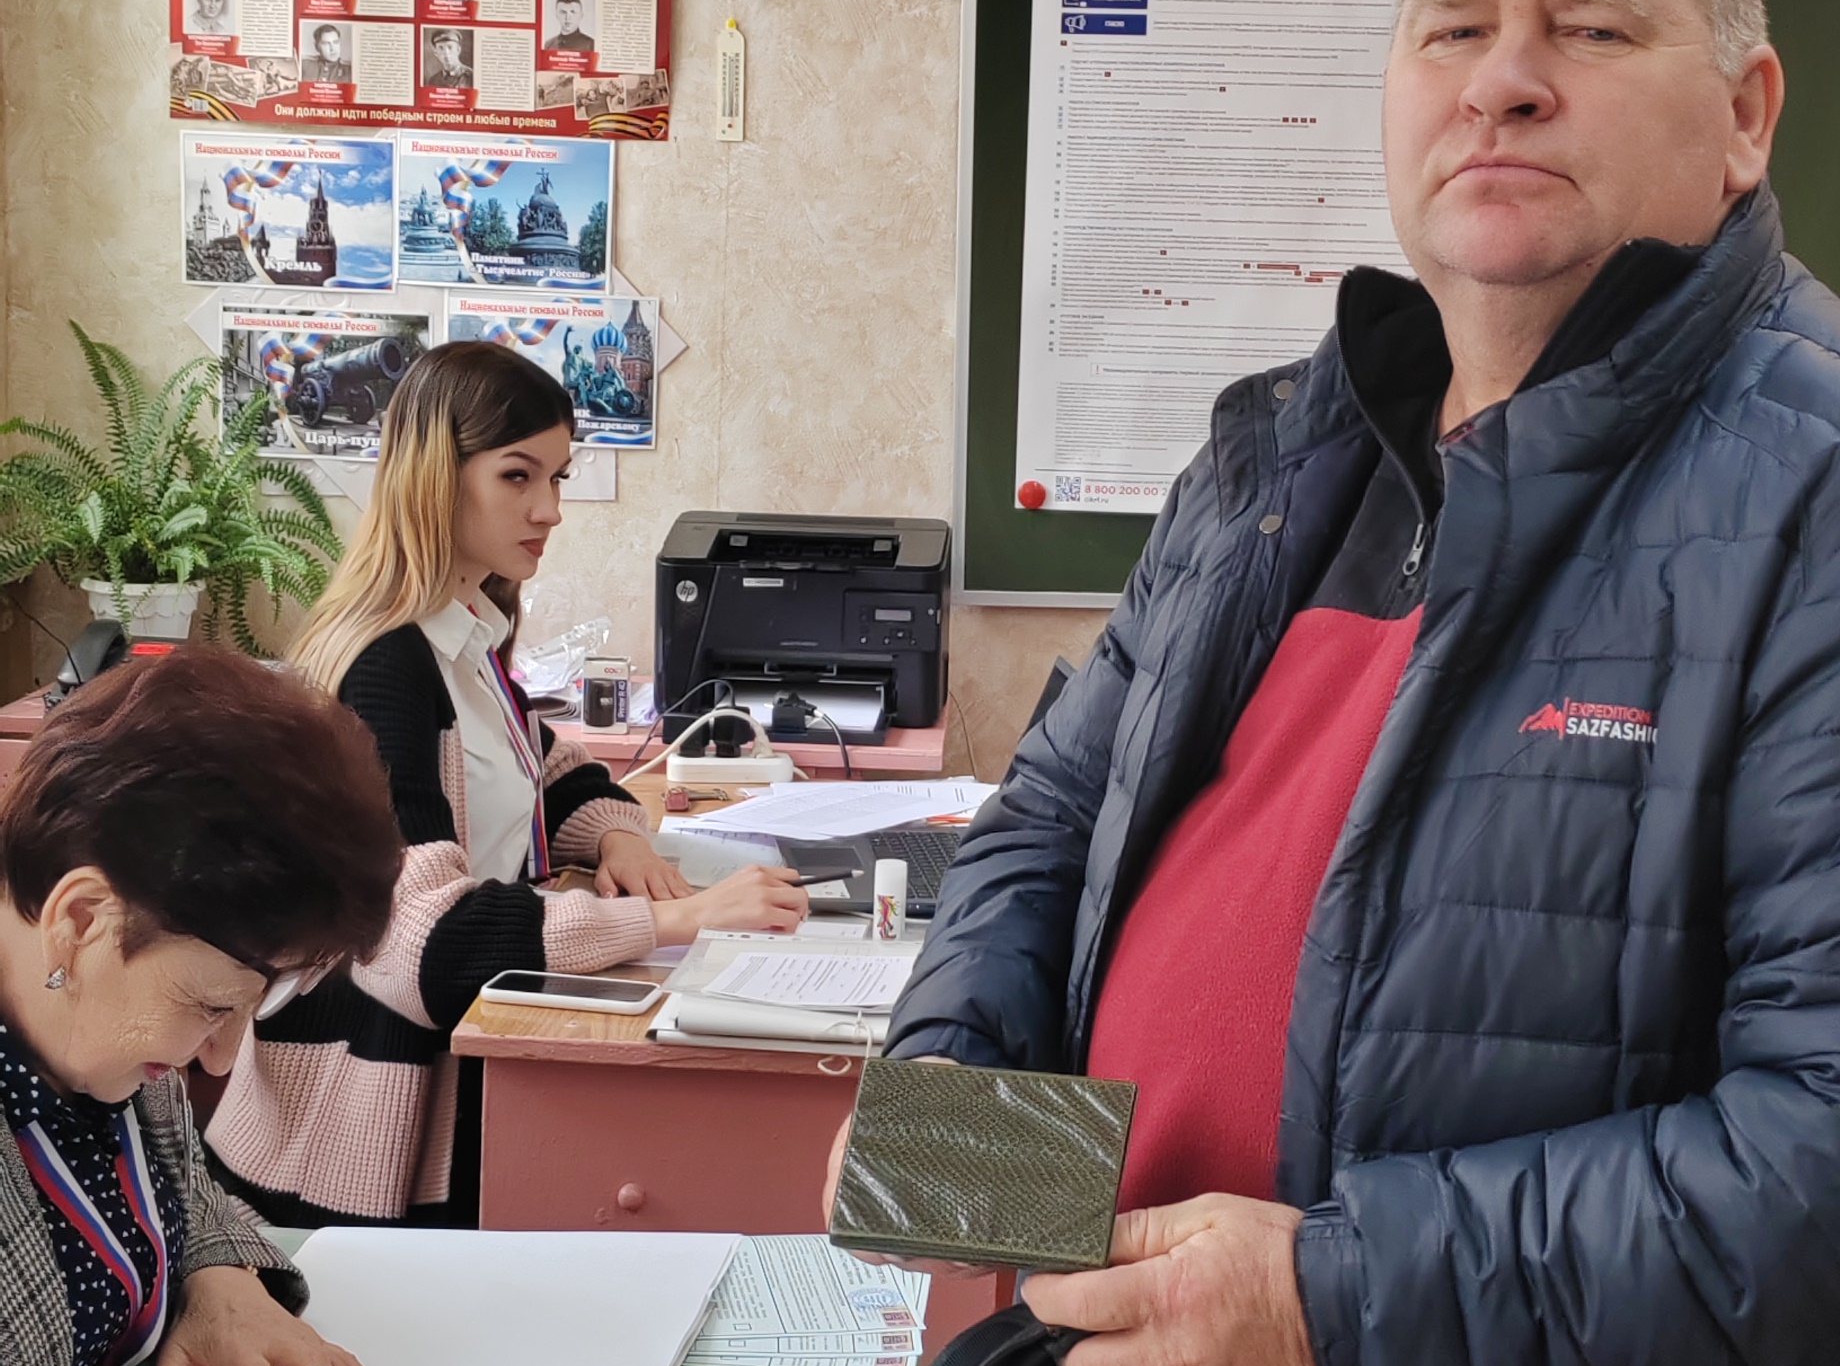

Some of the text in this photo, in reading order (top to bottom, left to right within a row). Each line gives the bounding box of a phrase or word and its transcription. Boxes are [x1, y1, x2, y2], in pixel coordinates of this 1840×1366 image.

[275, 104, 557, 130] Они должны идти победным строем в любые времена
[195, 142, 341, 159] Национальные символы России
[411, 141, 558, 159] Национальные символы России
[264, 256, 322, 272] Кремль
[470, 252, 525, 265] Памятник
[460, 300, 604, 317] Национальные символы России
[234, 315, 377, 332] Национальные символы России
[577, 419, 640, 432] Пожарскому
[1084, 485, 1091, 494] 8
[1094, 485, 1116, 495] 800
[1119, 486, 1141, 495] 200
[1143, 486, 1159, 496] 00
[680, 580, 695, 601] hp
[617, 697, 626, 718] Printer
[1568, 702, 1653, 723] EXPEDITION
